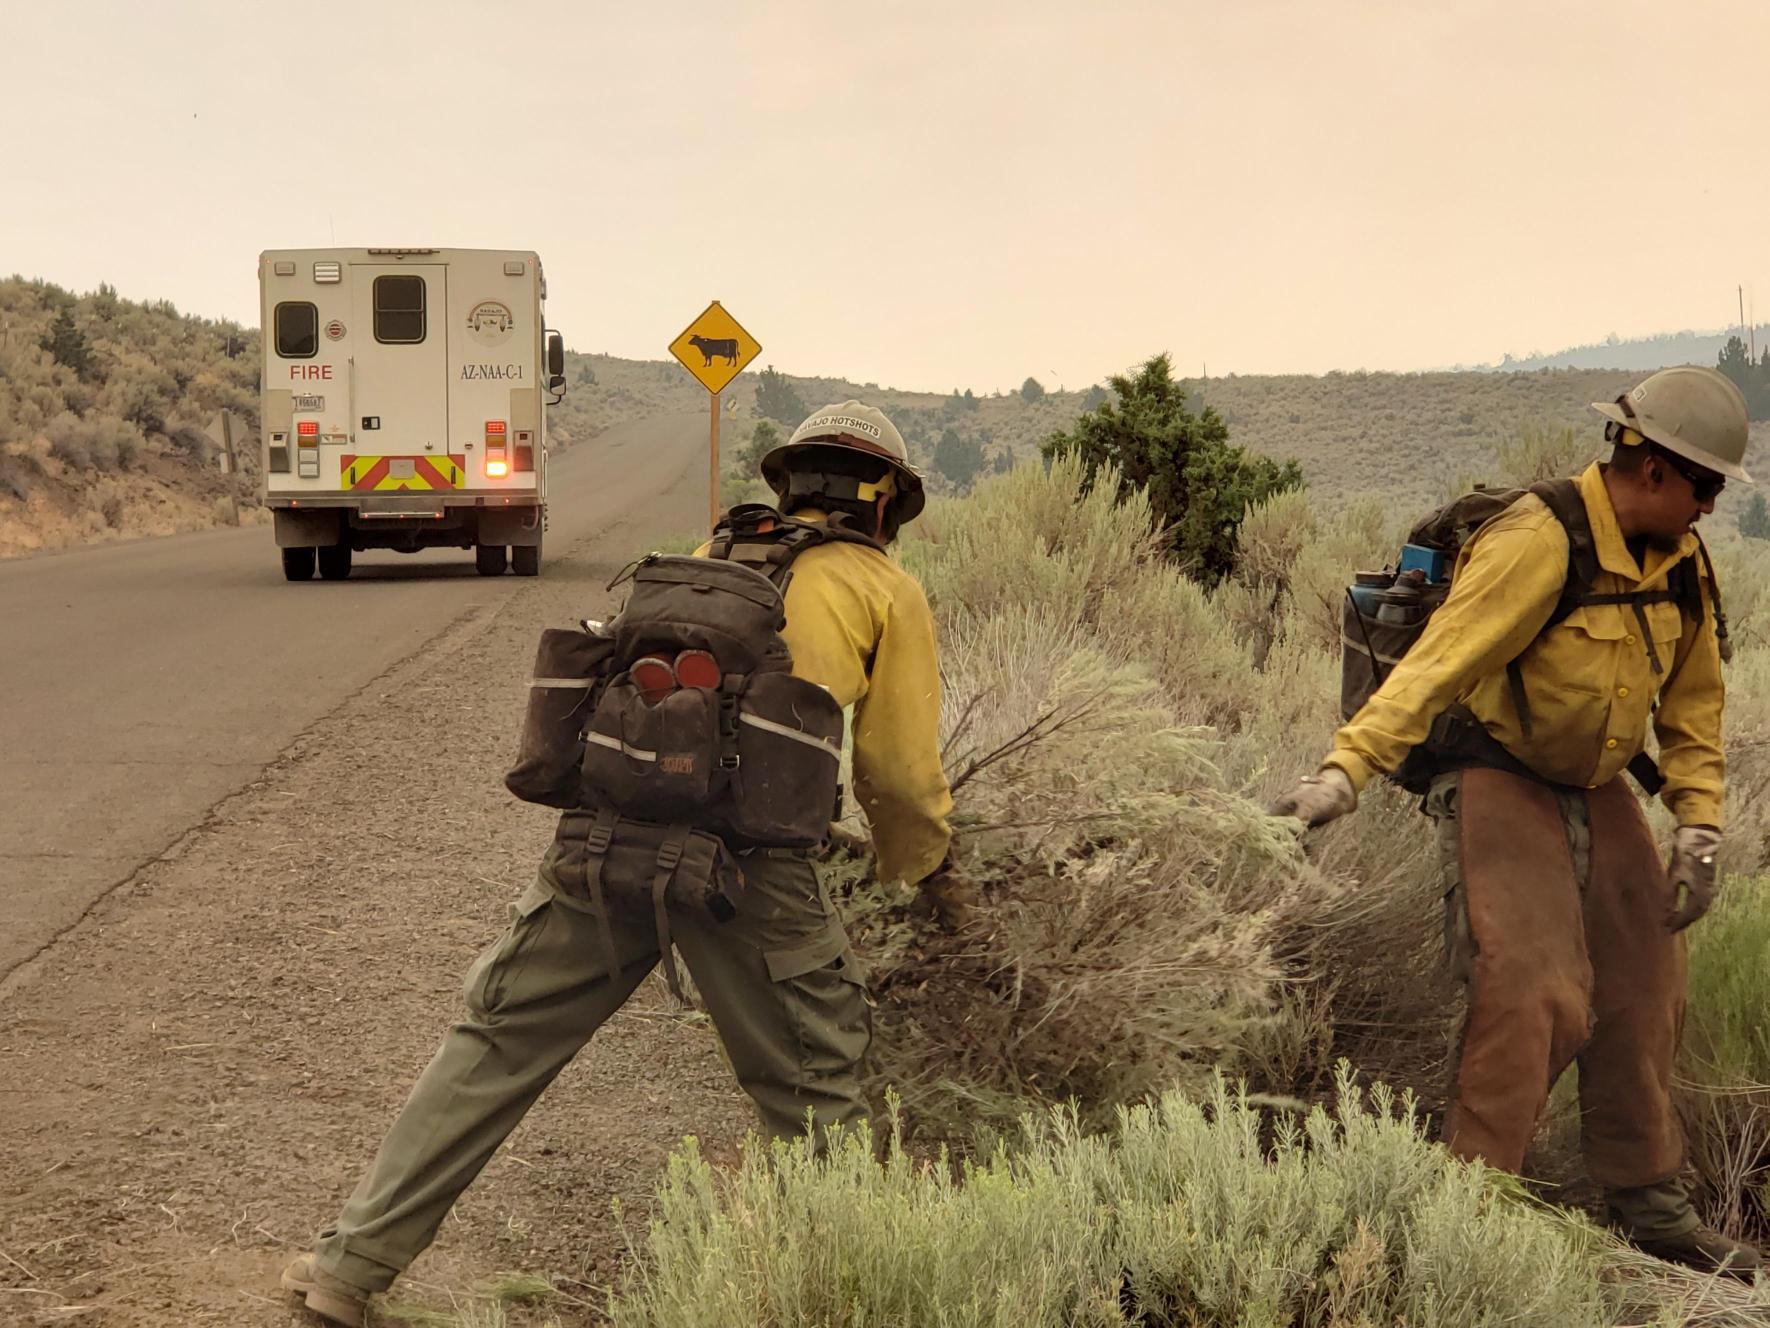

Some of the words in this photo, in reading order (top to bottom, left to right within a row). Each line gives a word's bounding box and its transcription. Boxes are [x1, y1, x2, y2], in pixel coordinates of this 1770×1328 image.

[290, 365, 333, 380] FIRE
[461, 364, 523, 380] AZ-NAA-C-1
[830, 416, 880, 436] HOTSHOTS
